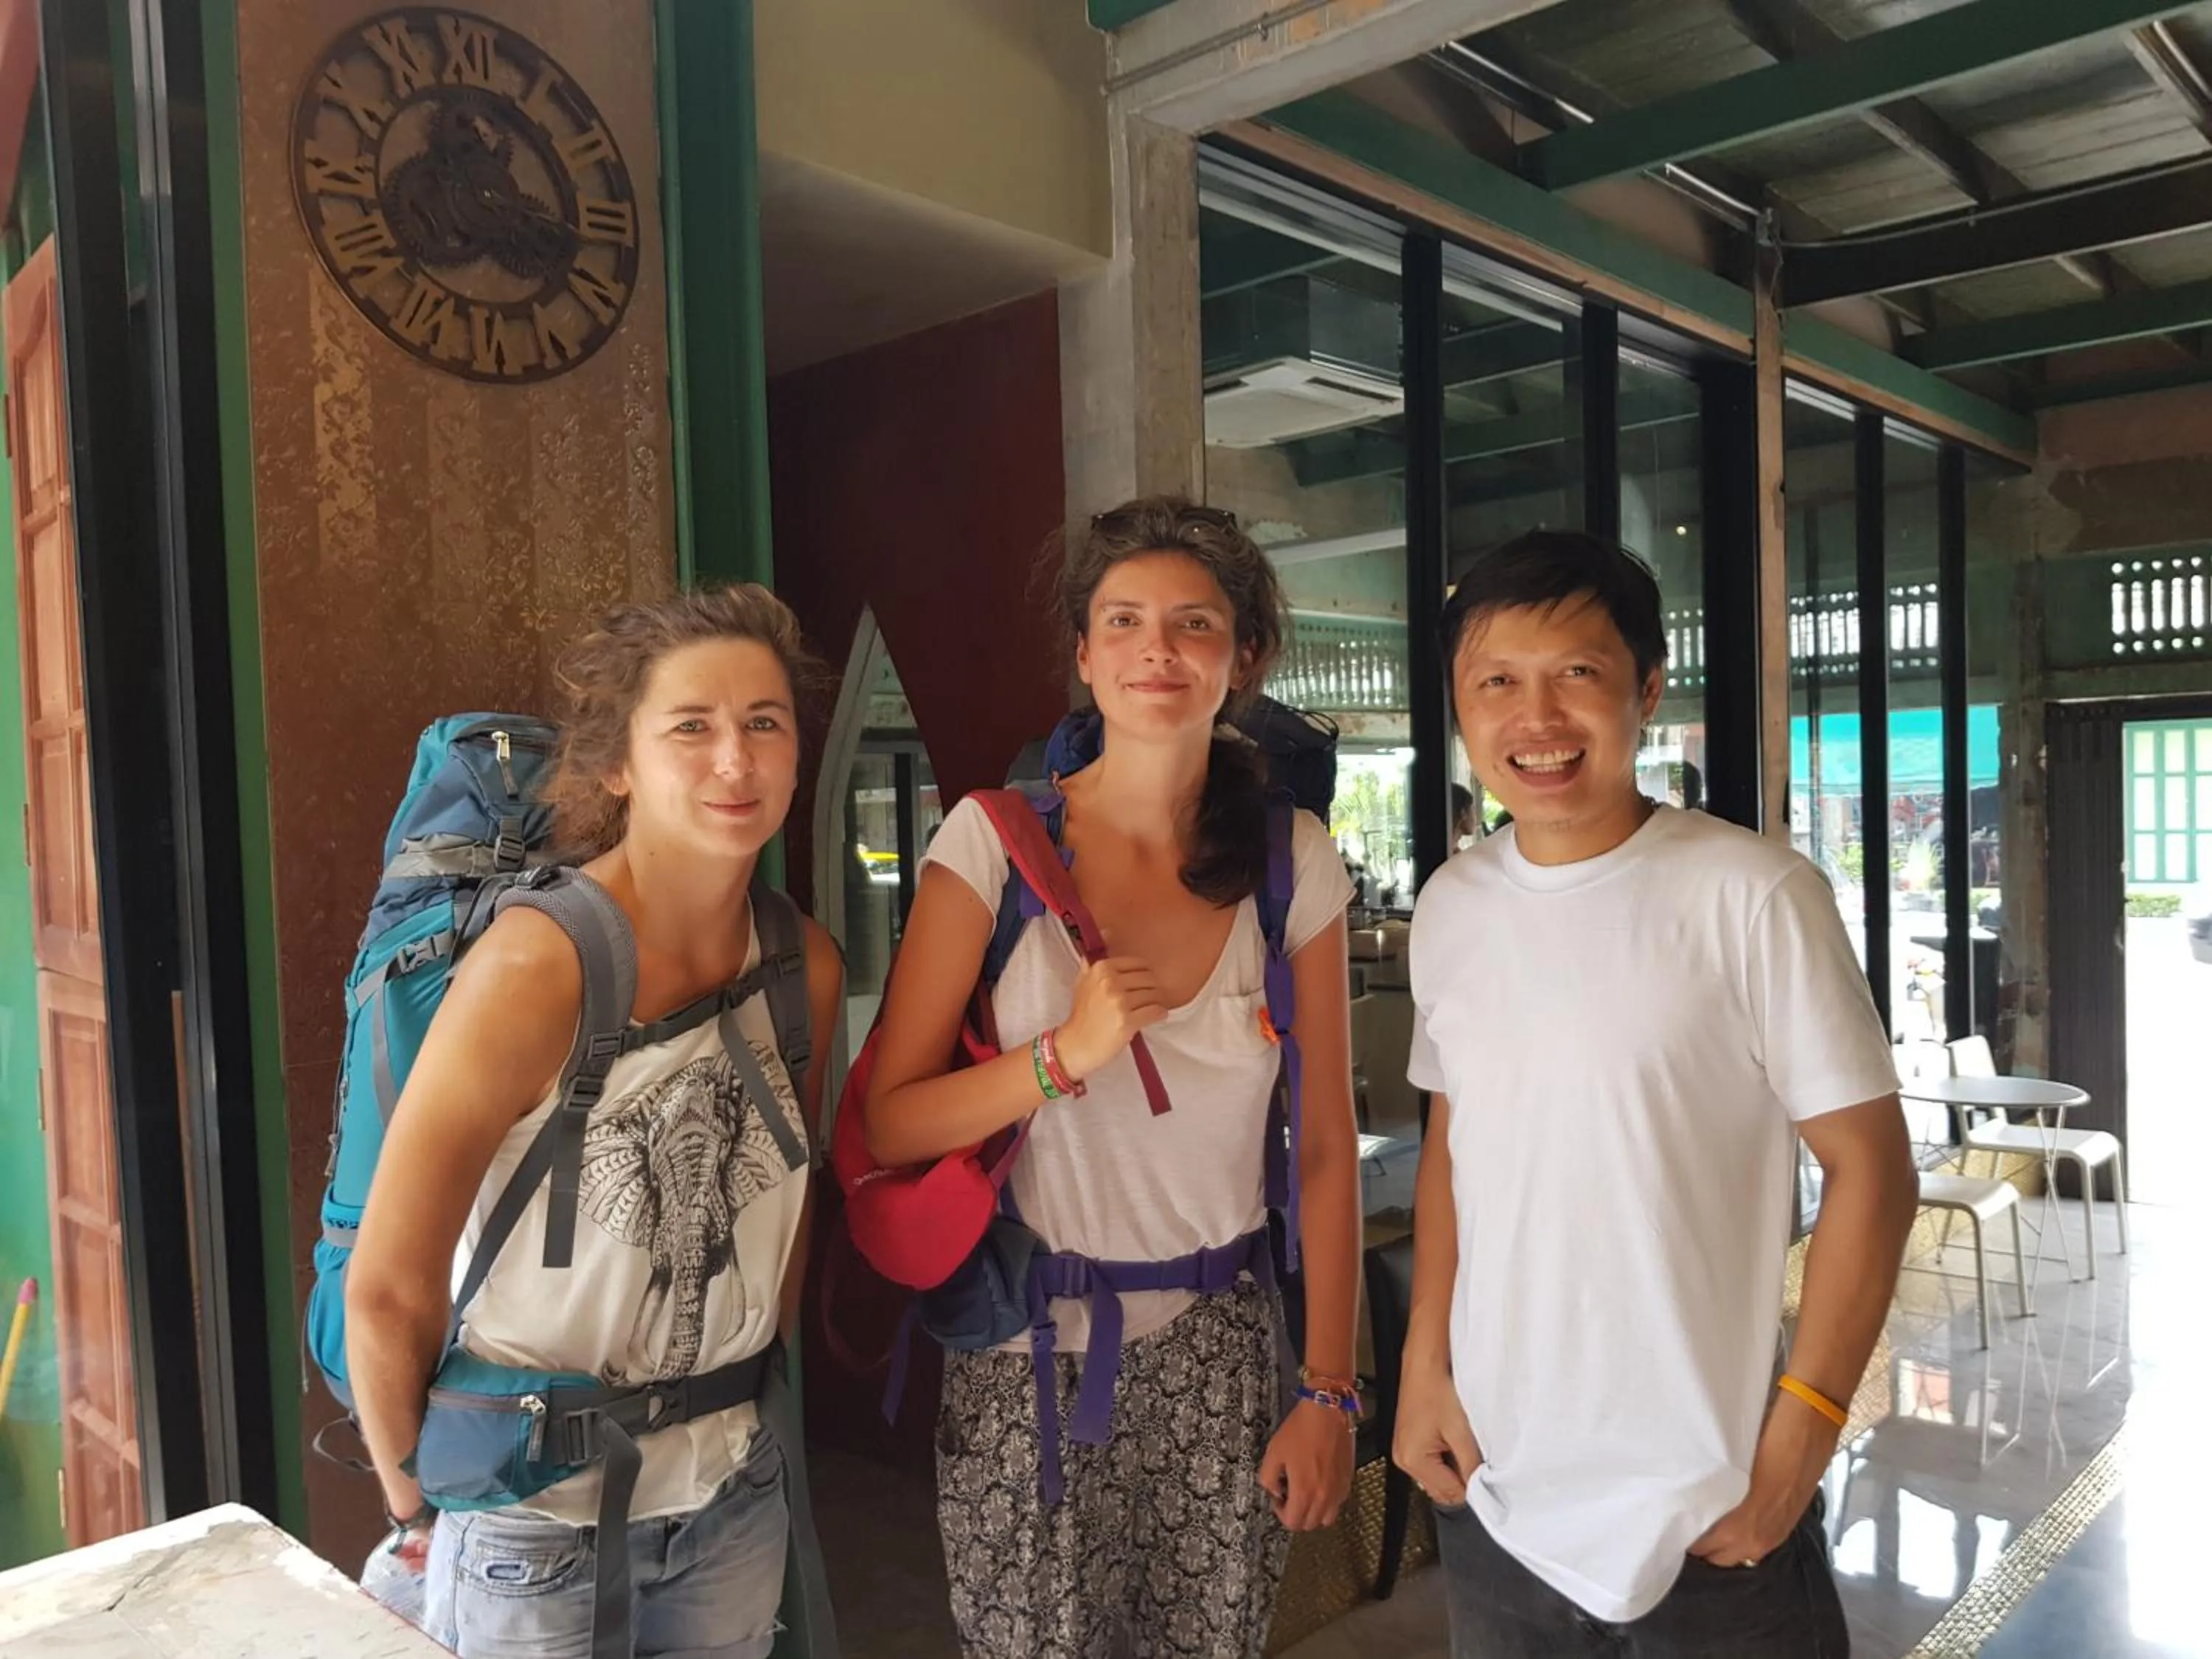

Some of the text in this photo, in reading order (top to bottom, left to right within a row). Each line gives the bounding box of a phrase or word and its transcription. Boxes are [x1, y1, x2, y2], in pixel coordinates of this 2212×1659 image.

[362, 15, 436, 98] XI
[435, 15, 495, 85] XII
[316, 59, 394, 139] X
[305, 139, 378, 199] IX
[553, 120, 617, 174] II
[321, 209, 406, 298] VIII
[577, 192, 634, 247] III
[391, 273, 454, 359] VII
[470, 305, 522, 375] VI
[532, 302, 582, 369] V
